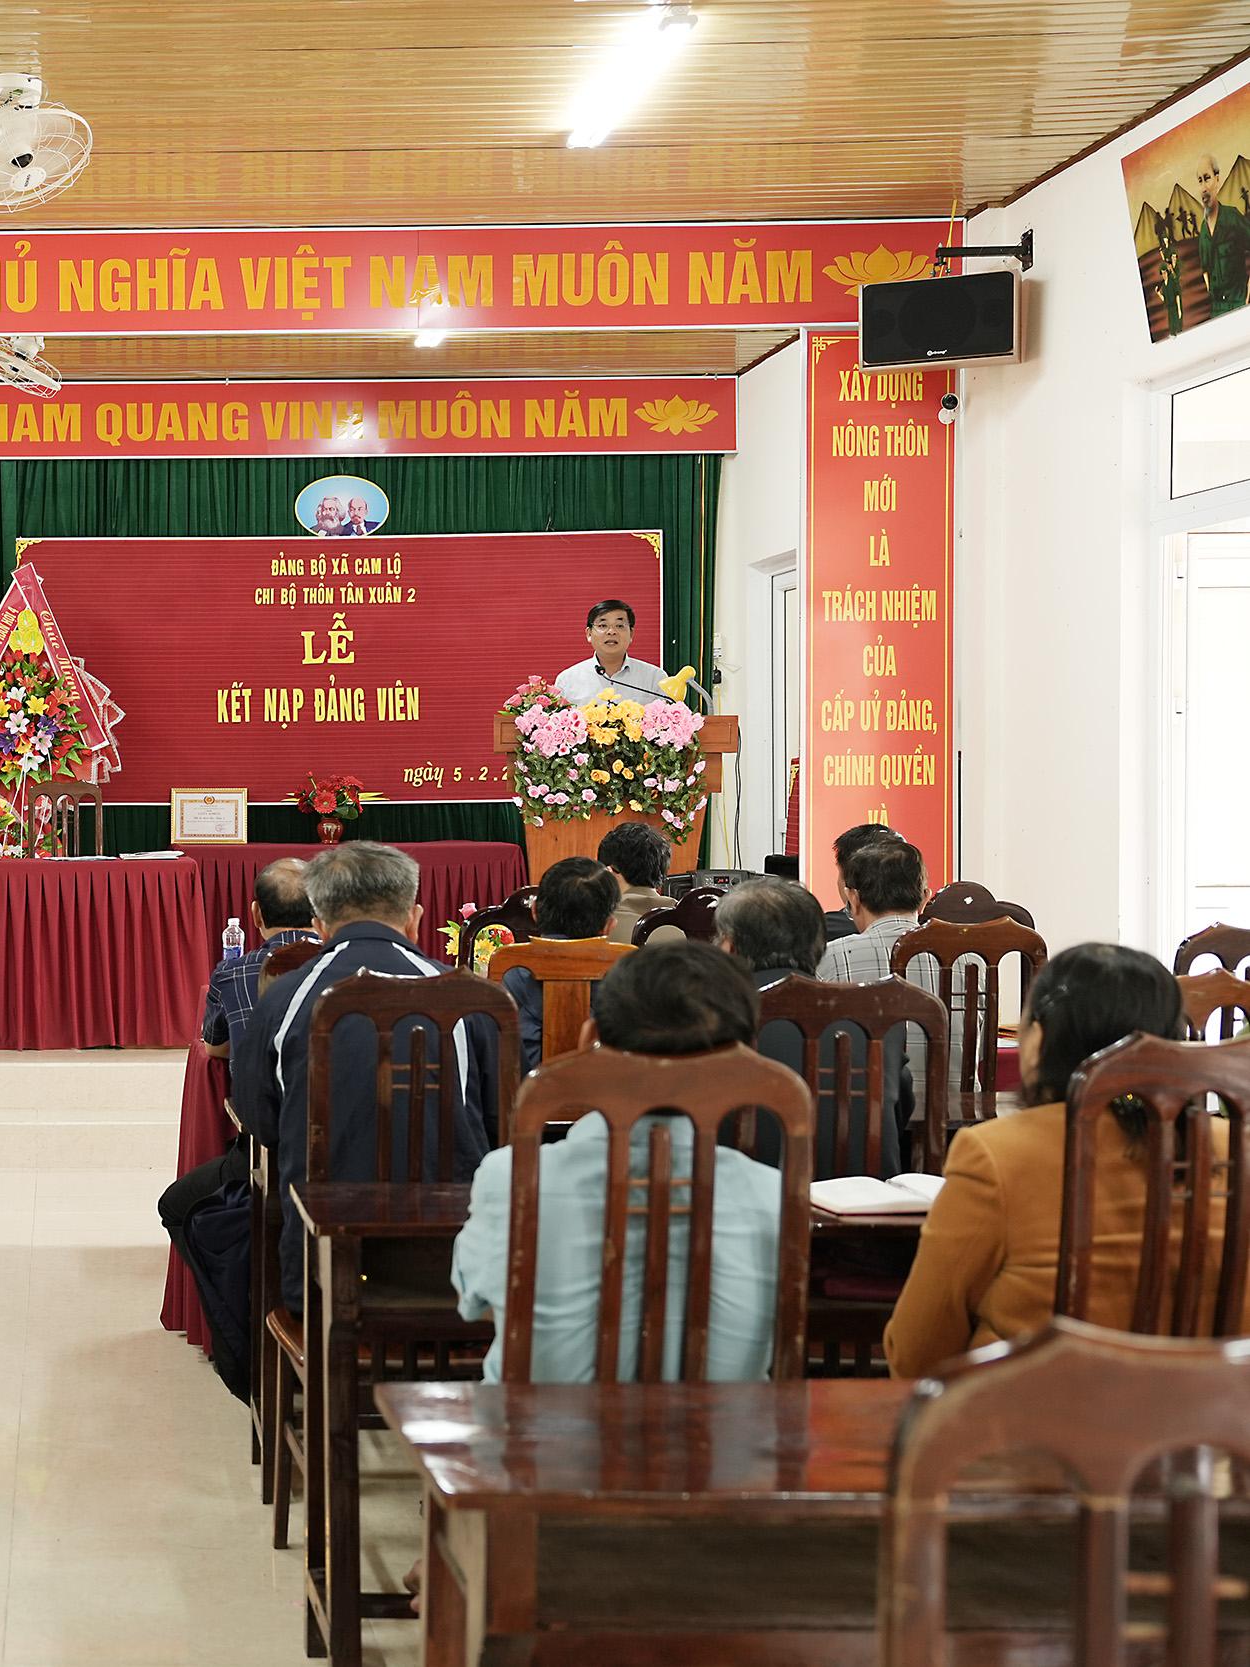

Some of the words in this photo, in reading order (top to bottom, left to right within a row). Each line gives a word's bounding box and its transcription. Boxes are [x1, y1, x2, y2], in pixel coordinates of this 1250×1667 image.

[59, 247, 224, 312] NGHĨA
[238, 244, 352, 320] VIỆT
[369, 255, 493, 308] NAM
[512, 240, 669, 307] MUÔN
[688, 238, 813, 305] NĂM
[839, 364, 871, 401] XÂY
[96, 402, 250, 447] QUANG
[261, 401, 364, 441] VINH
[377, 390, 511, 440] MUÔN
[525, 388, 628, 438] NĂM
[832, 418, 880, 457] NÔNG
[884, 418, 929, 457] THÔN
[863, 474, 897, 512] MỚI
[271, 552, 305, 576] ĐẢNG
[310, 554, 327, 580] BỘ
[331, 553, 350, 575] XÃ
[354, 557, 382, 576] CAM
[387, 553, 402, 580] LỘ
[869, 528, 891, 567] LÀ
[254, 587, 275, 605] CHI
[280, 583, 297, 610] BỘ
[303, 583, 334, 605] THÔN
[339, 582, 364, 604] TÂN
[368, 582, 402, 604] XUÂN
[406, 587, 416, 603] 2
[822, 584, 877, 623] TRÁCH
[881, 584, 937, 629] NHIỆM
[300, 612, 355, 665] LỄ
[862, 635, 897, 677] CỦA
[217, 681, 252, 723] KẾT
[264, 688, 304, 730] NẠP
[314, 674, 365, 722] ĐẢNG
[376, 679, 420, 722] VIÊN
[821, 689, 855, 732] CẤP
[860, 690, 882, 732] UỶ
[886, 690, 938, 735] ĐẢNG,
[403, 761, 445, 788] ngày
[823, 748, 875, 788] CHÍNH
[879, 745, 935, 790] QUYỀN
